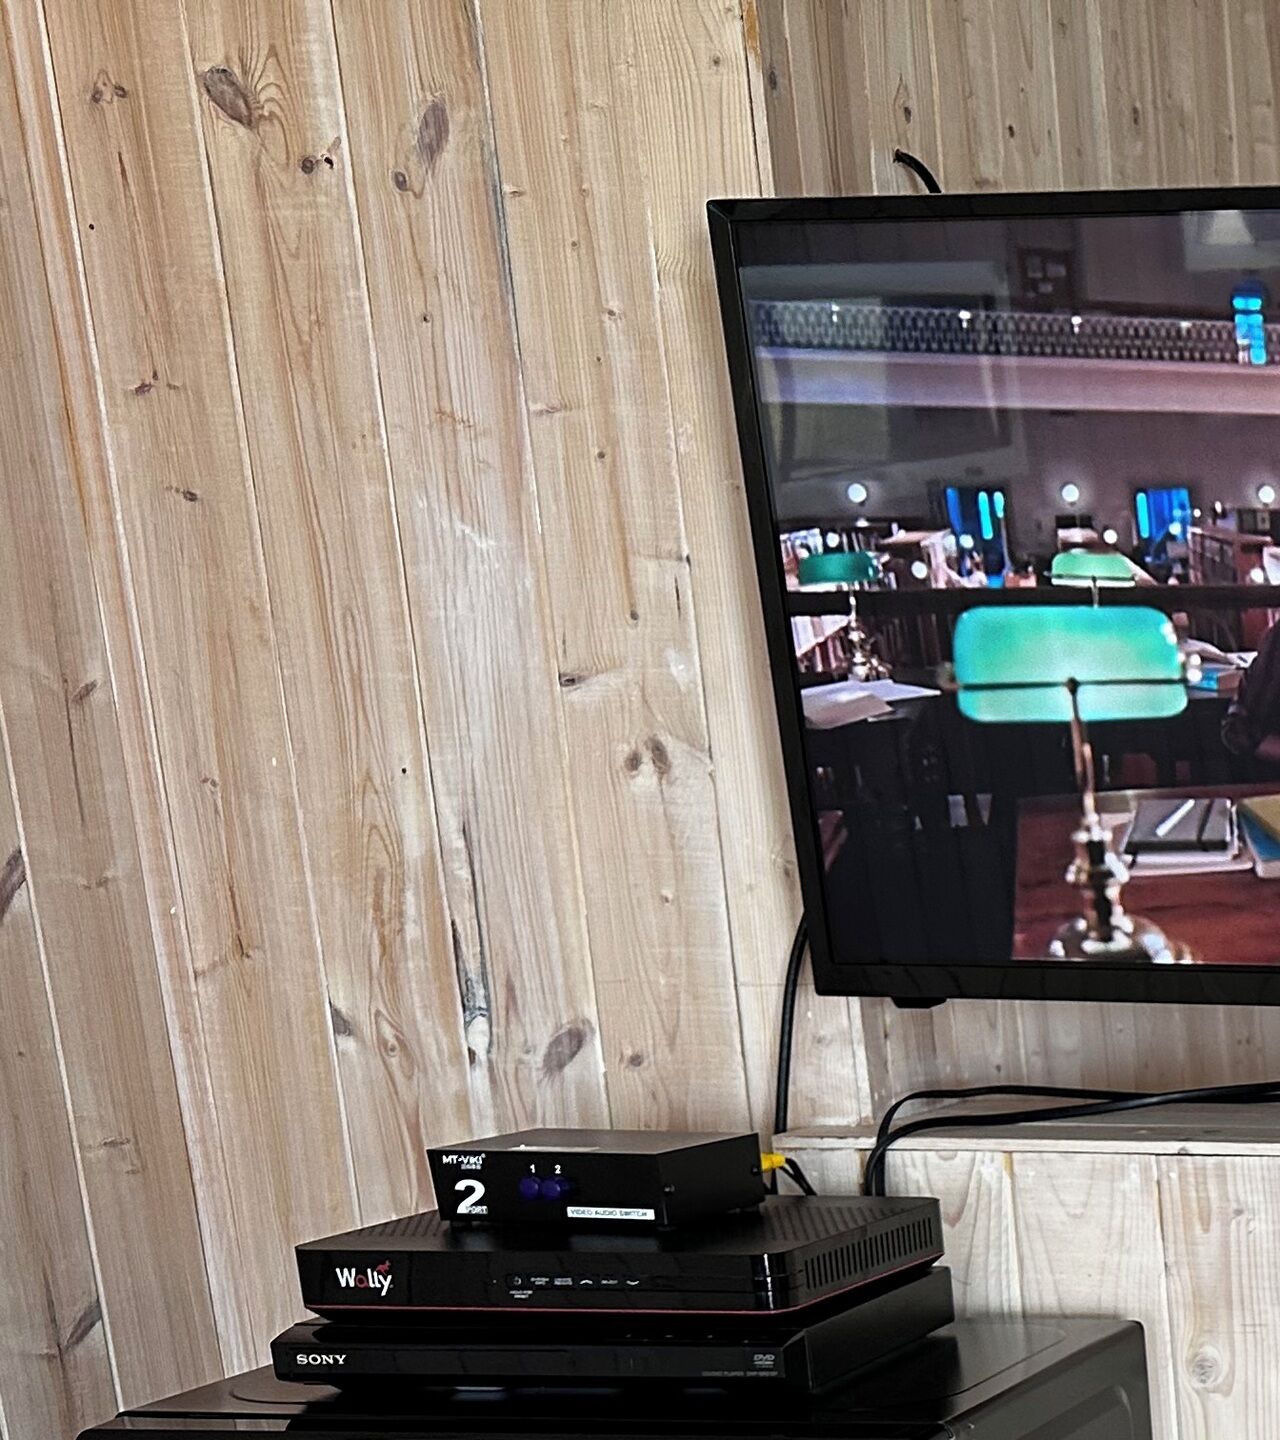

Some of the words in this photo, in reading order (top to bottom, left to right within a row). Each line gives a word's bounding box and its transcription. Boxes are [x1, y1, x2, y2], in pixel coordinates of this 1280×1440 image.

[530, 1163, 536, 1174] 1
[555, 1163, 562, 1174] 2
[454, 1178, 486, 1214] 2
[336, 1267, 392, 1297] Wally
[296, 1354, 347, 1365] SONY
